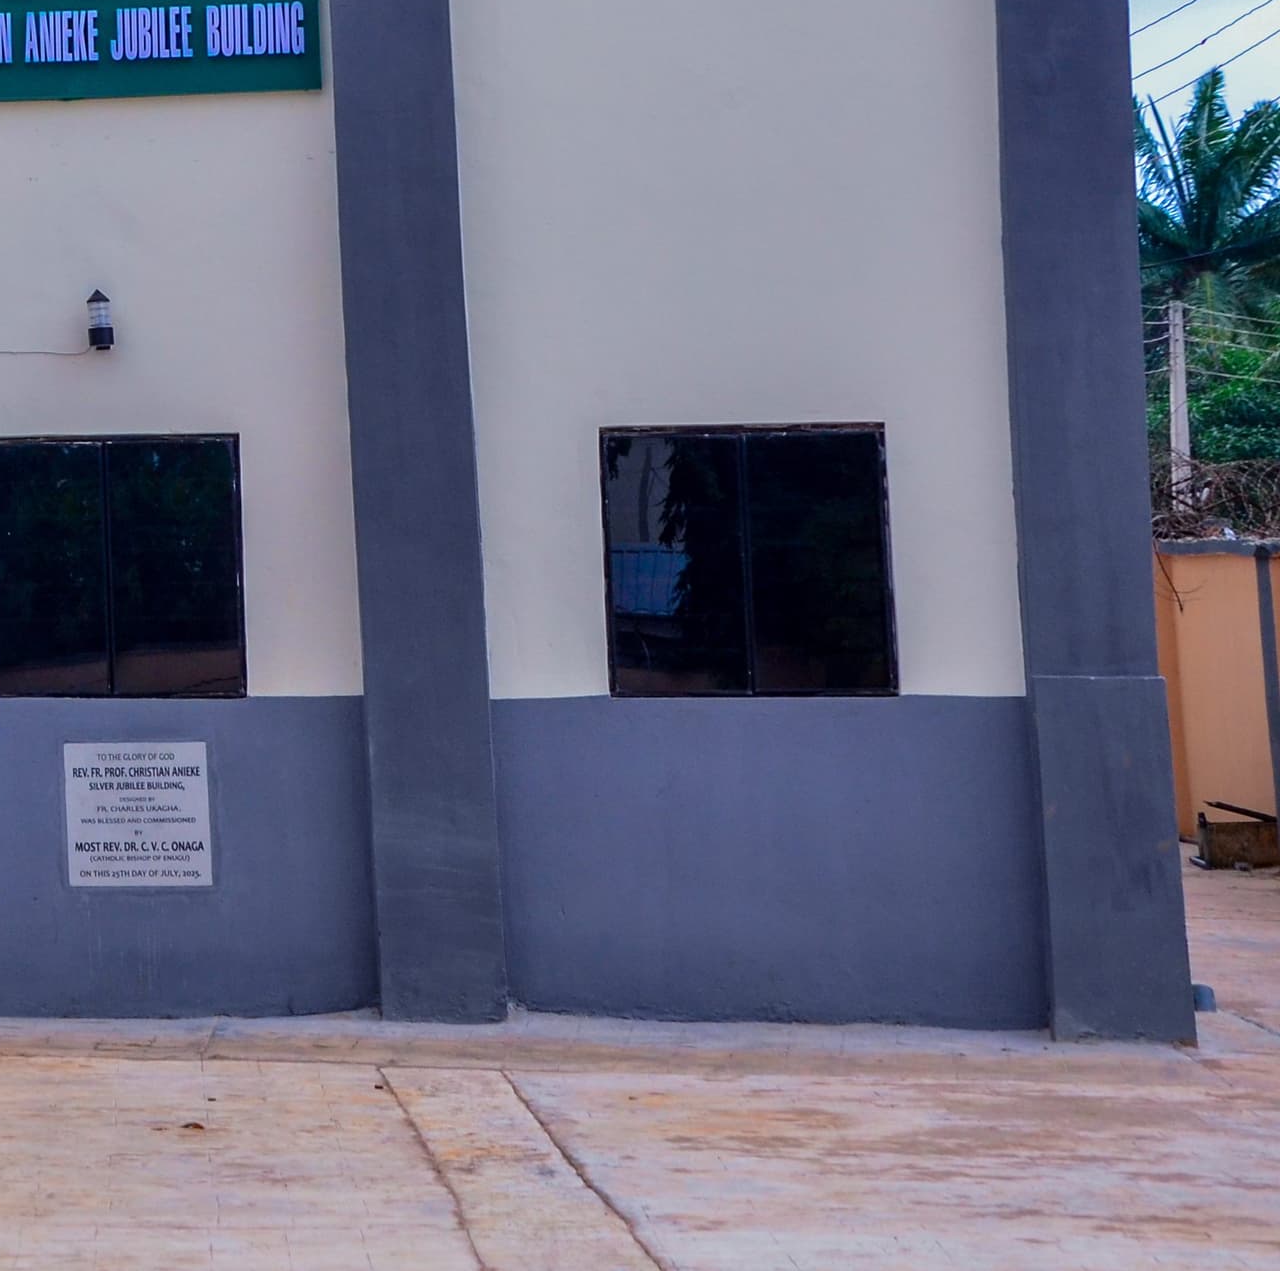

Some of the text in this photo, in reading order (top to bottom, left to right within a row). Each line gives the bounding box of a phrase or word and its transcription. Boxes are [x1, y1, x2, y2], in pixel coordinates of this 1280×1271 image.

[24, 10, 99, 63] ANIEKE
[110, 6, 193, 61] JUBILEE
[206, 1, 305, 57] BUILDING
[72, 767, 200, 778] REV. FR. PROF. CHRISTIAN ANIEKE
[89, 782, 113, 791] SILVER
[116, 782, 145, 790] JUBILEE
[75, 841, 204, 852] MOST REV. DR. C. V. C. ONAGA
[80, 870, 91, 878] ON
[94, 870, 110, 878] THIS
